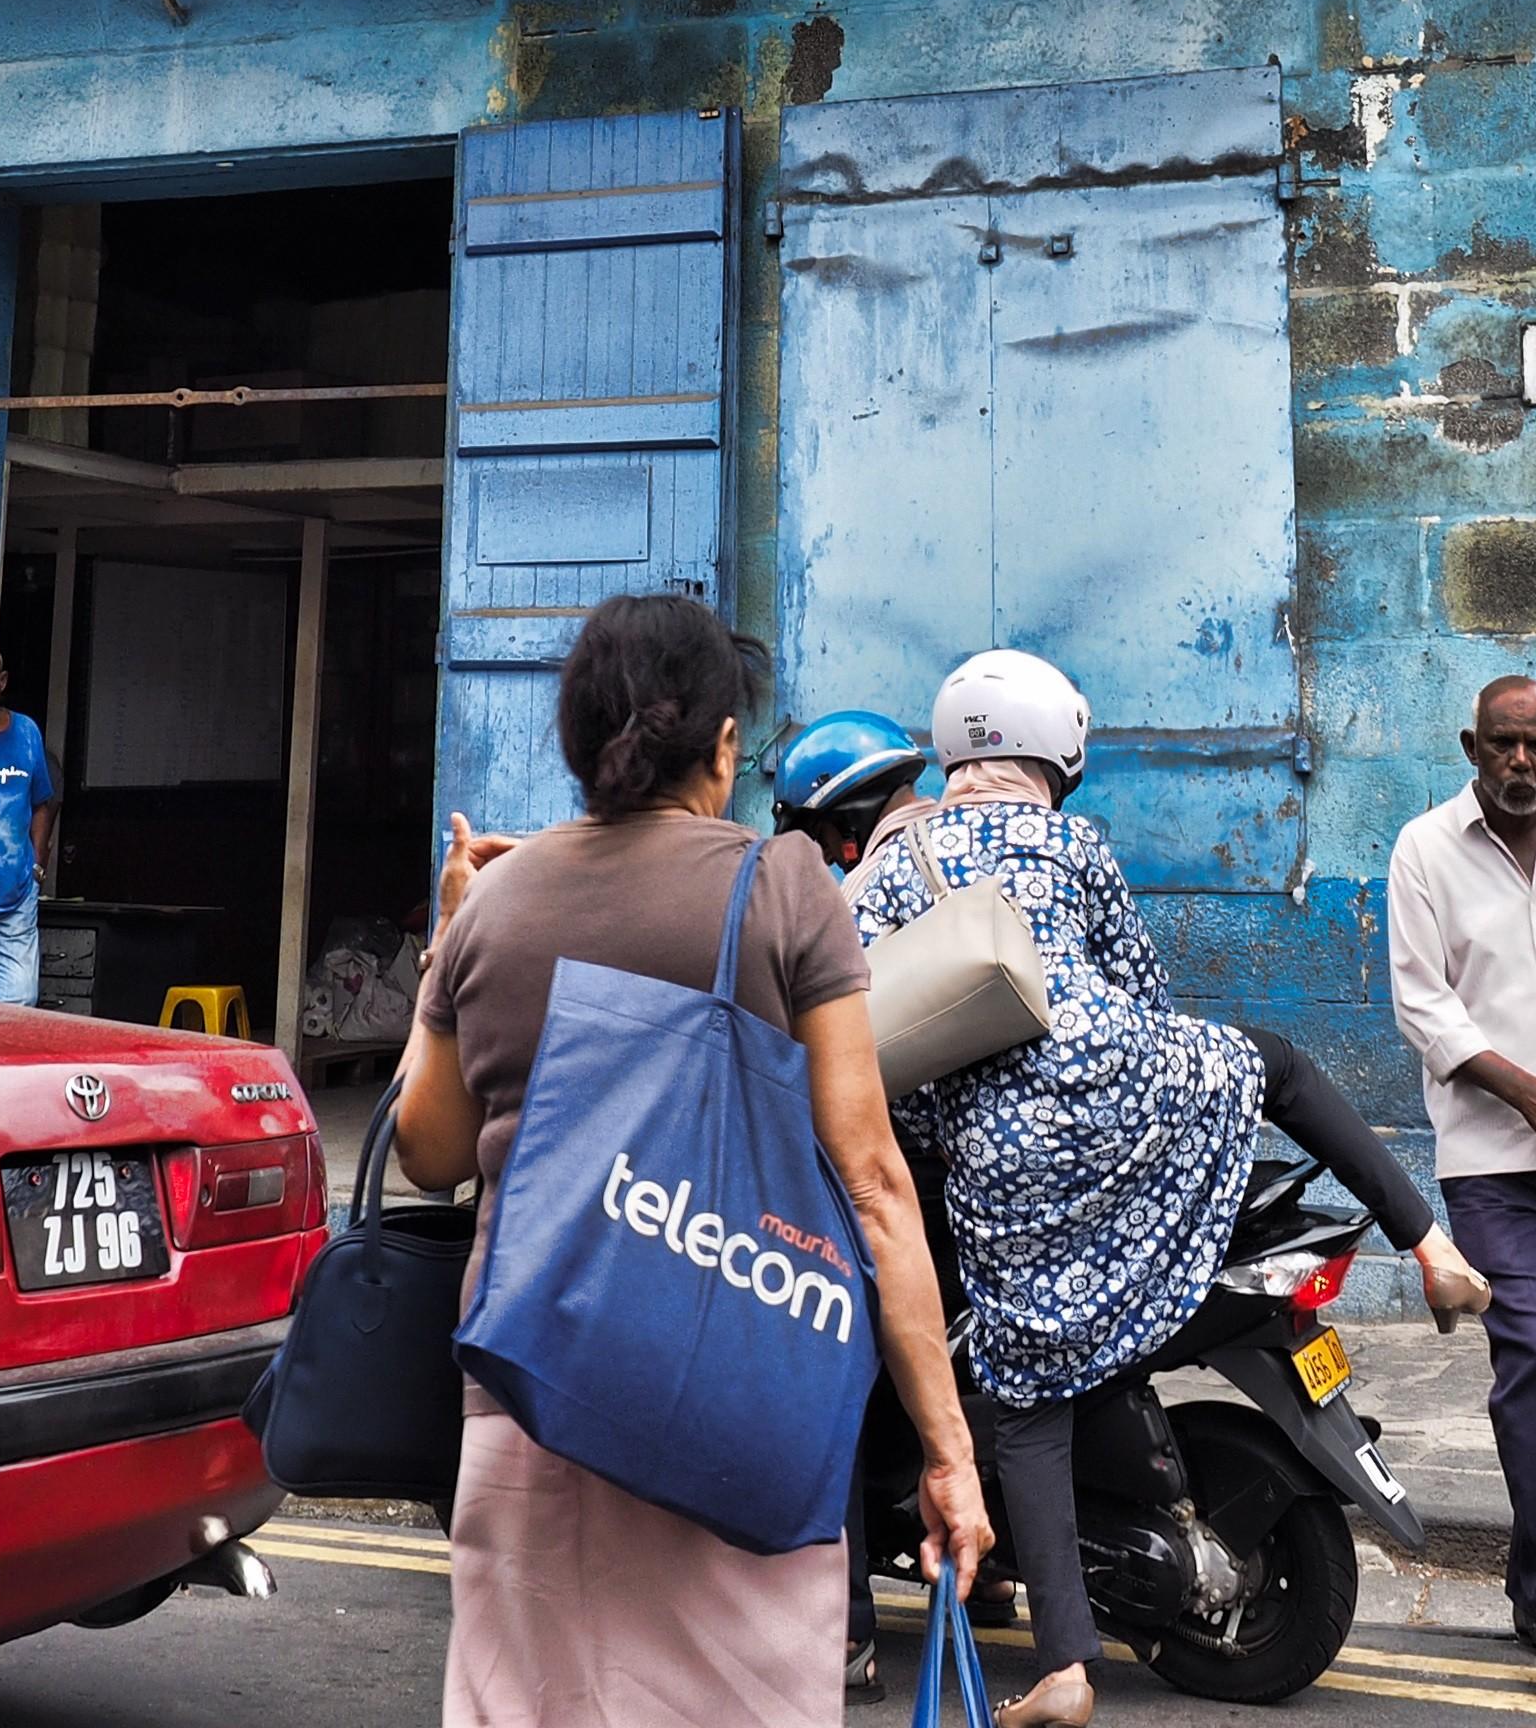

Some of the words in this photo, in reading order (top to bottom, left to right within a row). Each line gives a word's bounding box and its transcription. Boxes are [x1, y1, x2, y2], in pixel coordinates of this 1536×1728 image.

[231, 1082, 292, 1102] CORONA
[52, 1152, 116, 1210] 725
[43, 1214, 87, 1276] ZJ
[96, 1210, 142, 1270] 96
[603, 1152, 854, 1344] telecom
[1303, 1352, 1332, 1391] 4456
